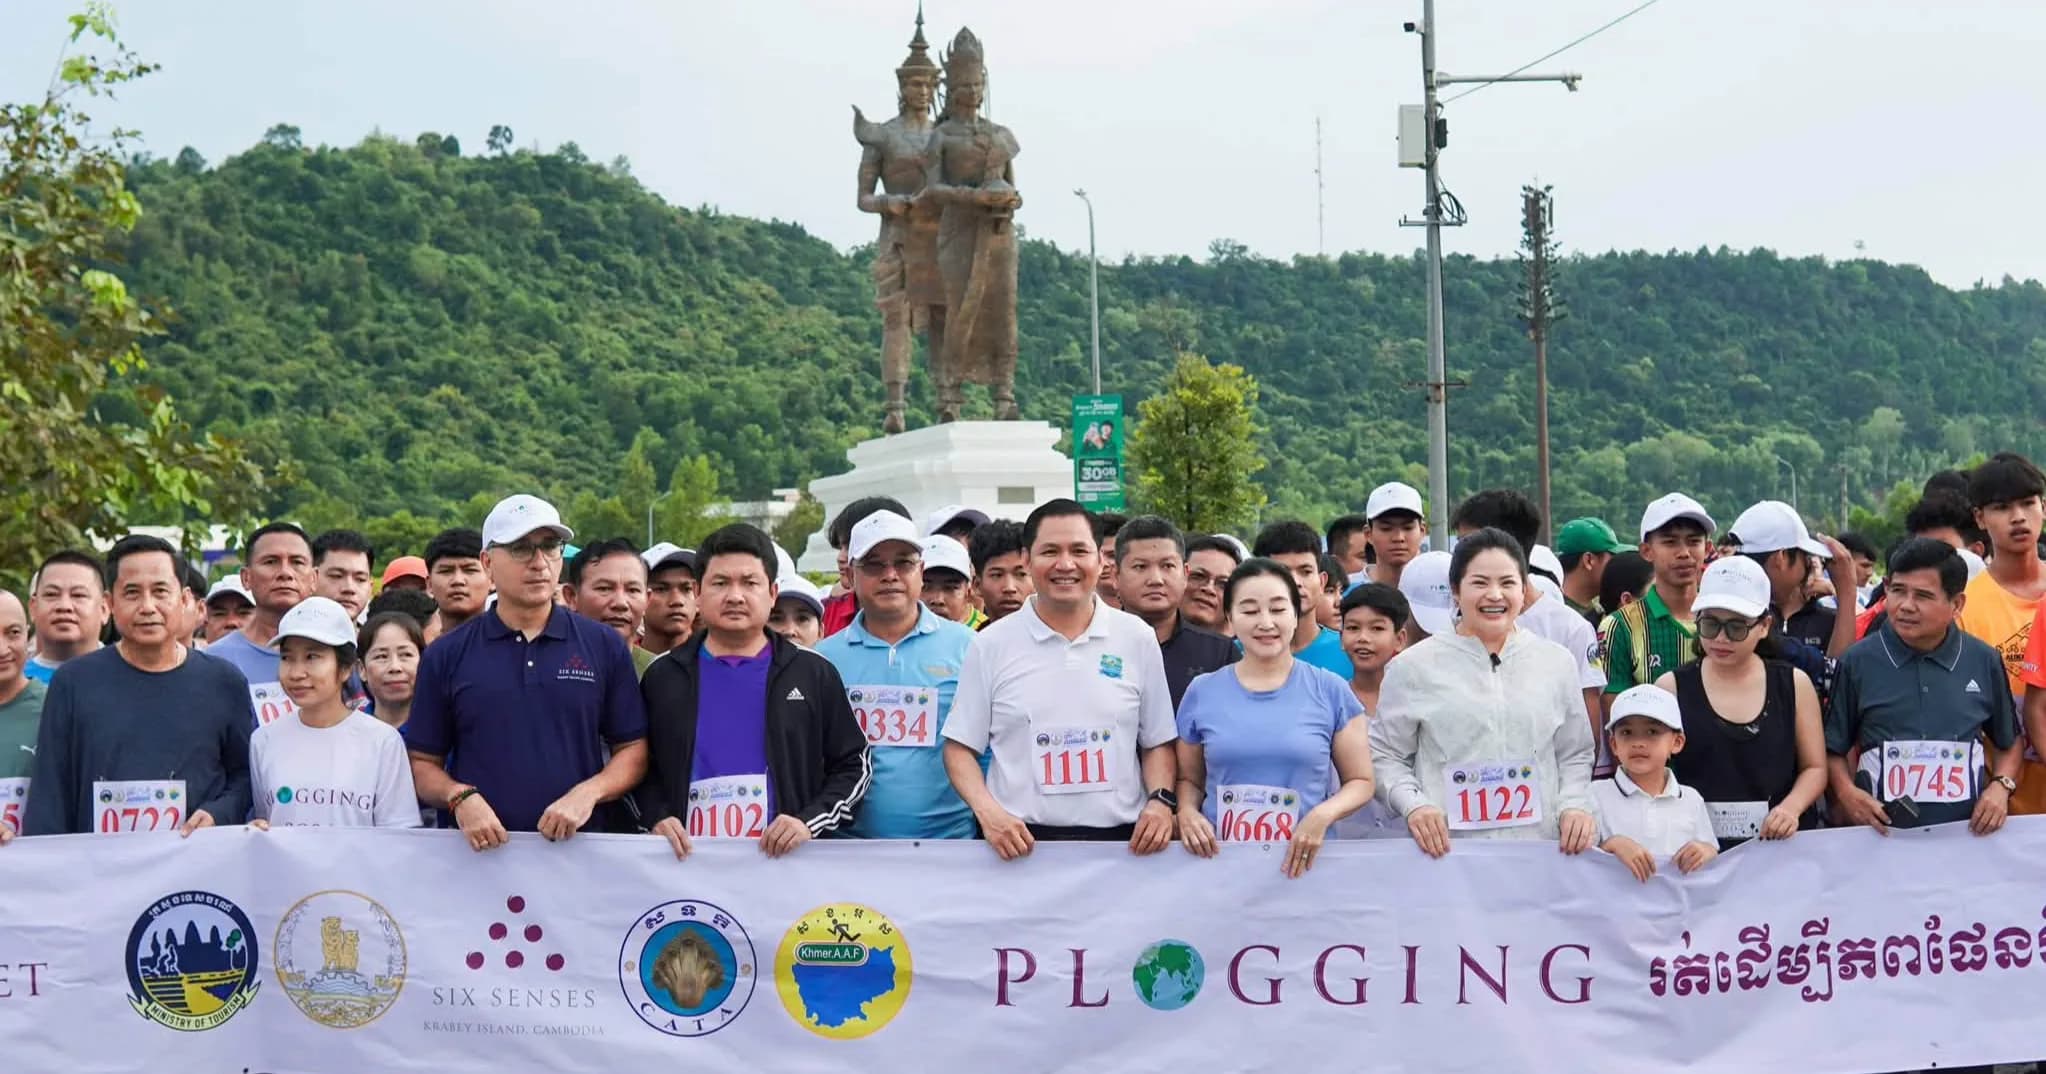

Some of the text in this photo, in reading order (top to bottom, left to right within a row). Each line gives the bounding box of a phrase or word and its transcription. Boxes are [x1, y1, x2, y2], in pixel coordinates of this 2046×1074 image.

[1040, 748, 1109, 786] 1111
[1888, 764, 1965, 799] 0745
[101, 806, 180, 833] 0722
[1456, 784, 1533, 822] 1122
[689, 803, 764, 838] 0102
[1221, 808, 1294, 841] 0668
[150, 994, 243, 1029] MINISTRY OF TOURISM
[432, 986, 596, 1009] SIX SENSES
[423, 1021, 473, 1033] KRABEY
[532, 1024, 606, 1037] CAMBODIA
[640, 1002, 733, 1032] CATA
